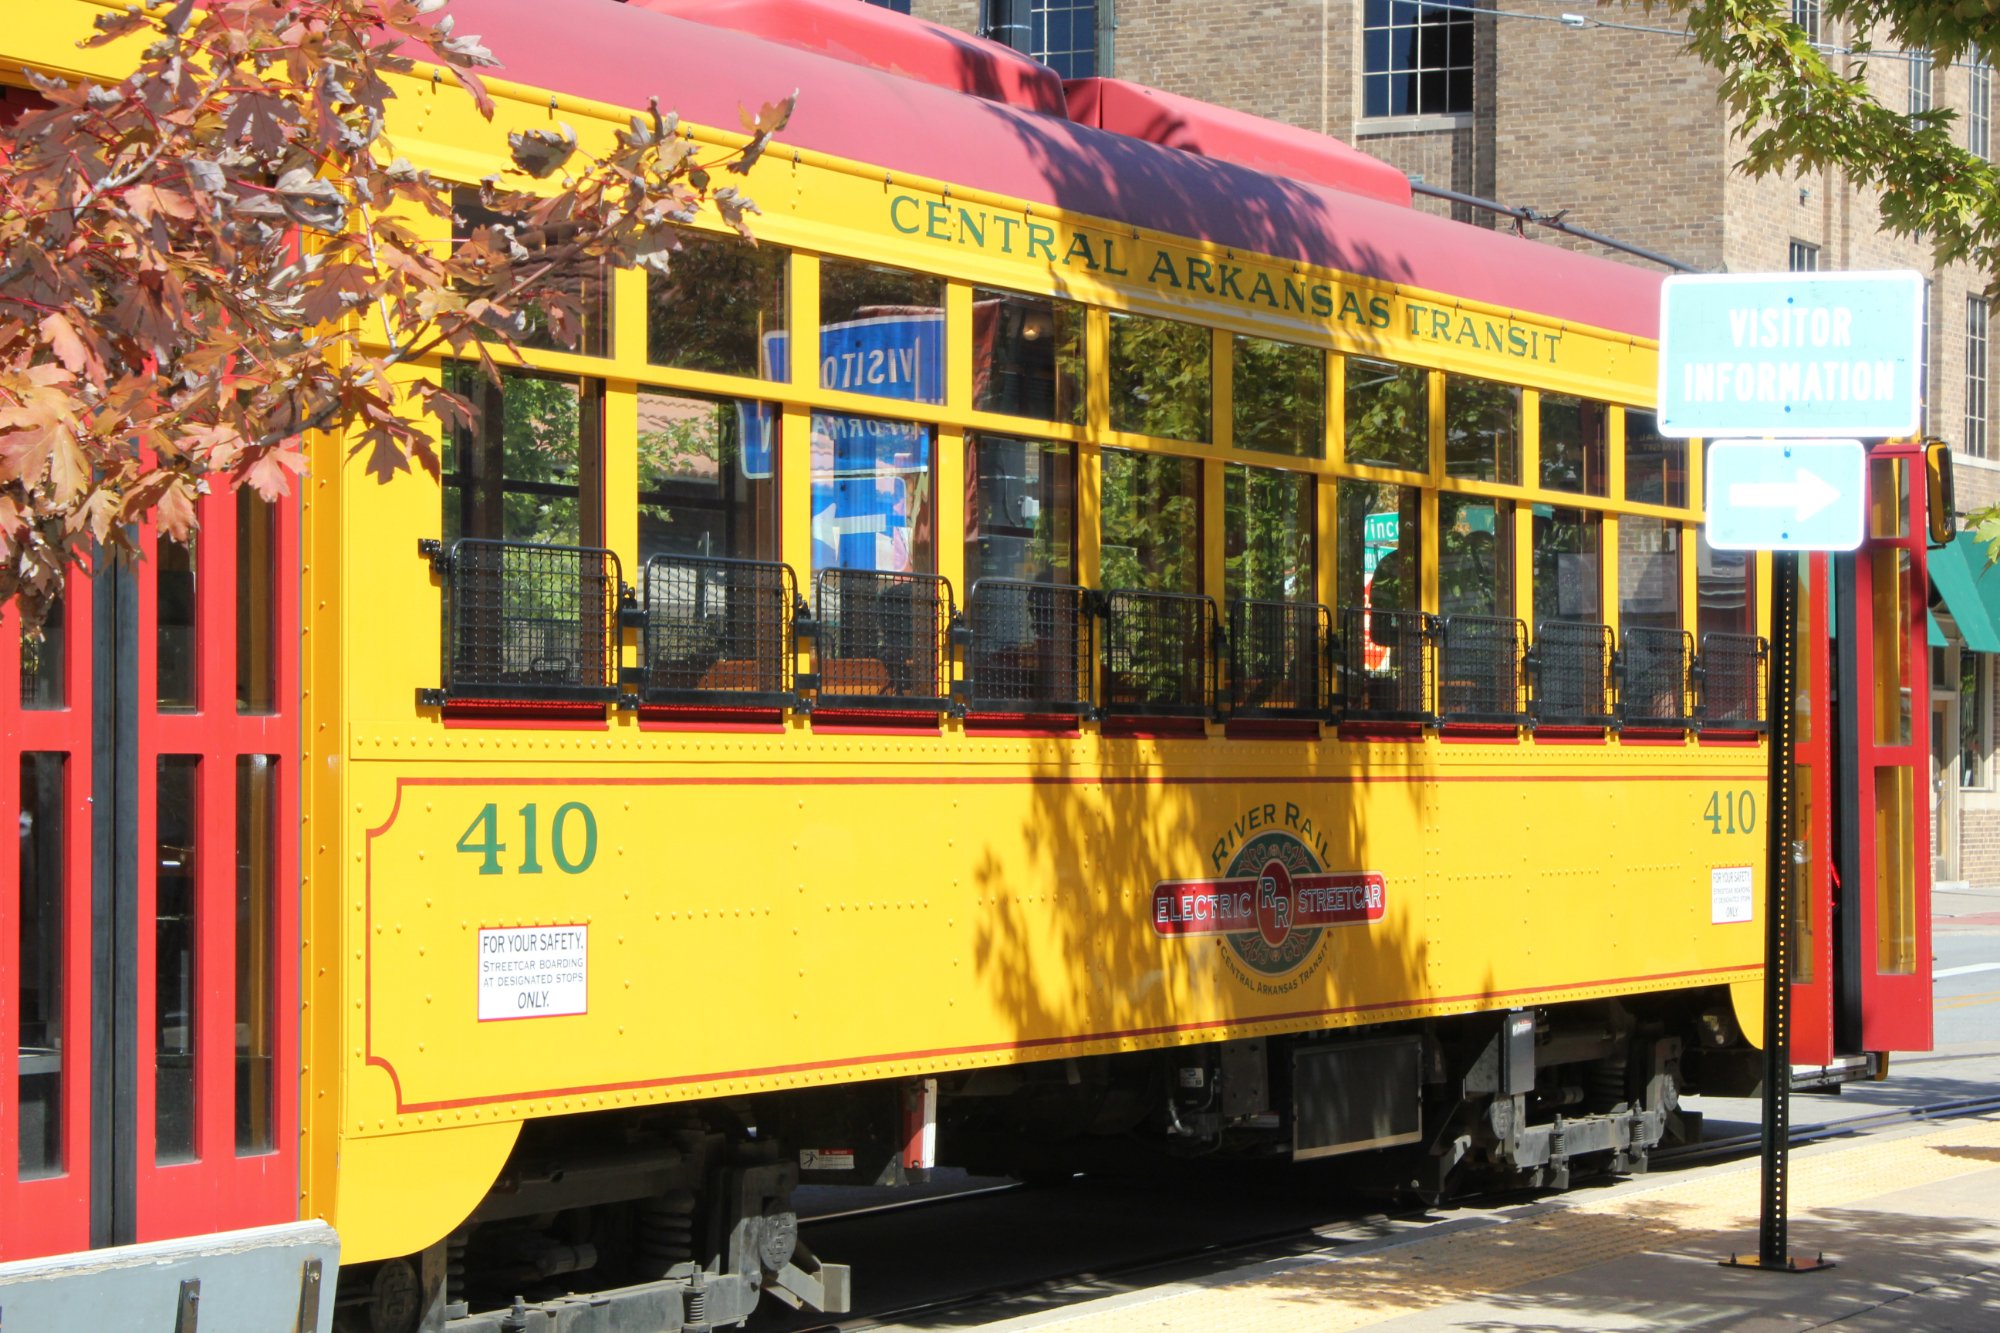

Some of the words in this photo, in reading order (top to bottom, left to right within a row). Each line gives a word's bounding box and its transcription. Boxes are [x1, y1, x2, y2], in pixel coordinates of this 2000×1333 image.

[890, 195, 1128, 277] CENTRAL
[1147, 250, 1392, 330] ARKANSAS
[1406, 302, 1562, 364] TRANSIT
[1729, 307, 1853, 349] VISITOR
[1683, 361, 1895, 402] INFORMATION
[1703, 789, 1756, 835] 410
[456, 801, 598, 875] 410
[1211, 803, 1277, 873] RIVER
[1284, 801, 1332, 869] RAIL
[1157, 892, 1252, 922] ELECTRIC
[1298, 883, 1382, 914] STREETCAR
[483, 935, 505, 954] FOR
[507, 934, 537, 953] YOUR
[483, 960, 536, 973] STREETCAR
[539, 957, 584, 970] BOARDING
[483, 977, 494, 988] AT
[497, 974, 553, 987] DESIGNATED
[556, 972, 584, 983] STOPS
[1220, 945, 1256, 991] CENTRAL
[1256, 979, 1299, 996] ARKANSAS
[1299, 944, 1329, 985] TRANSIT
